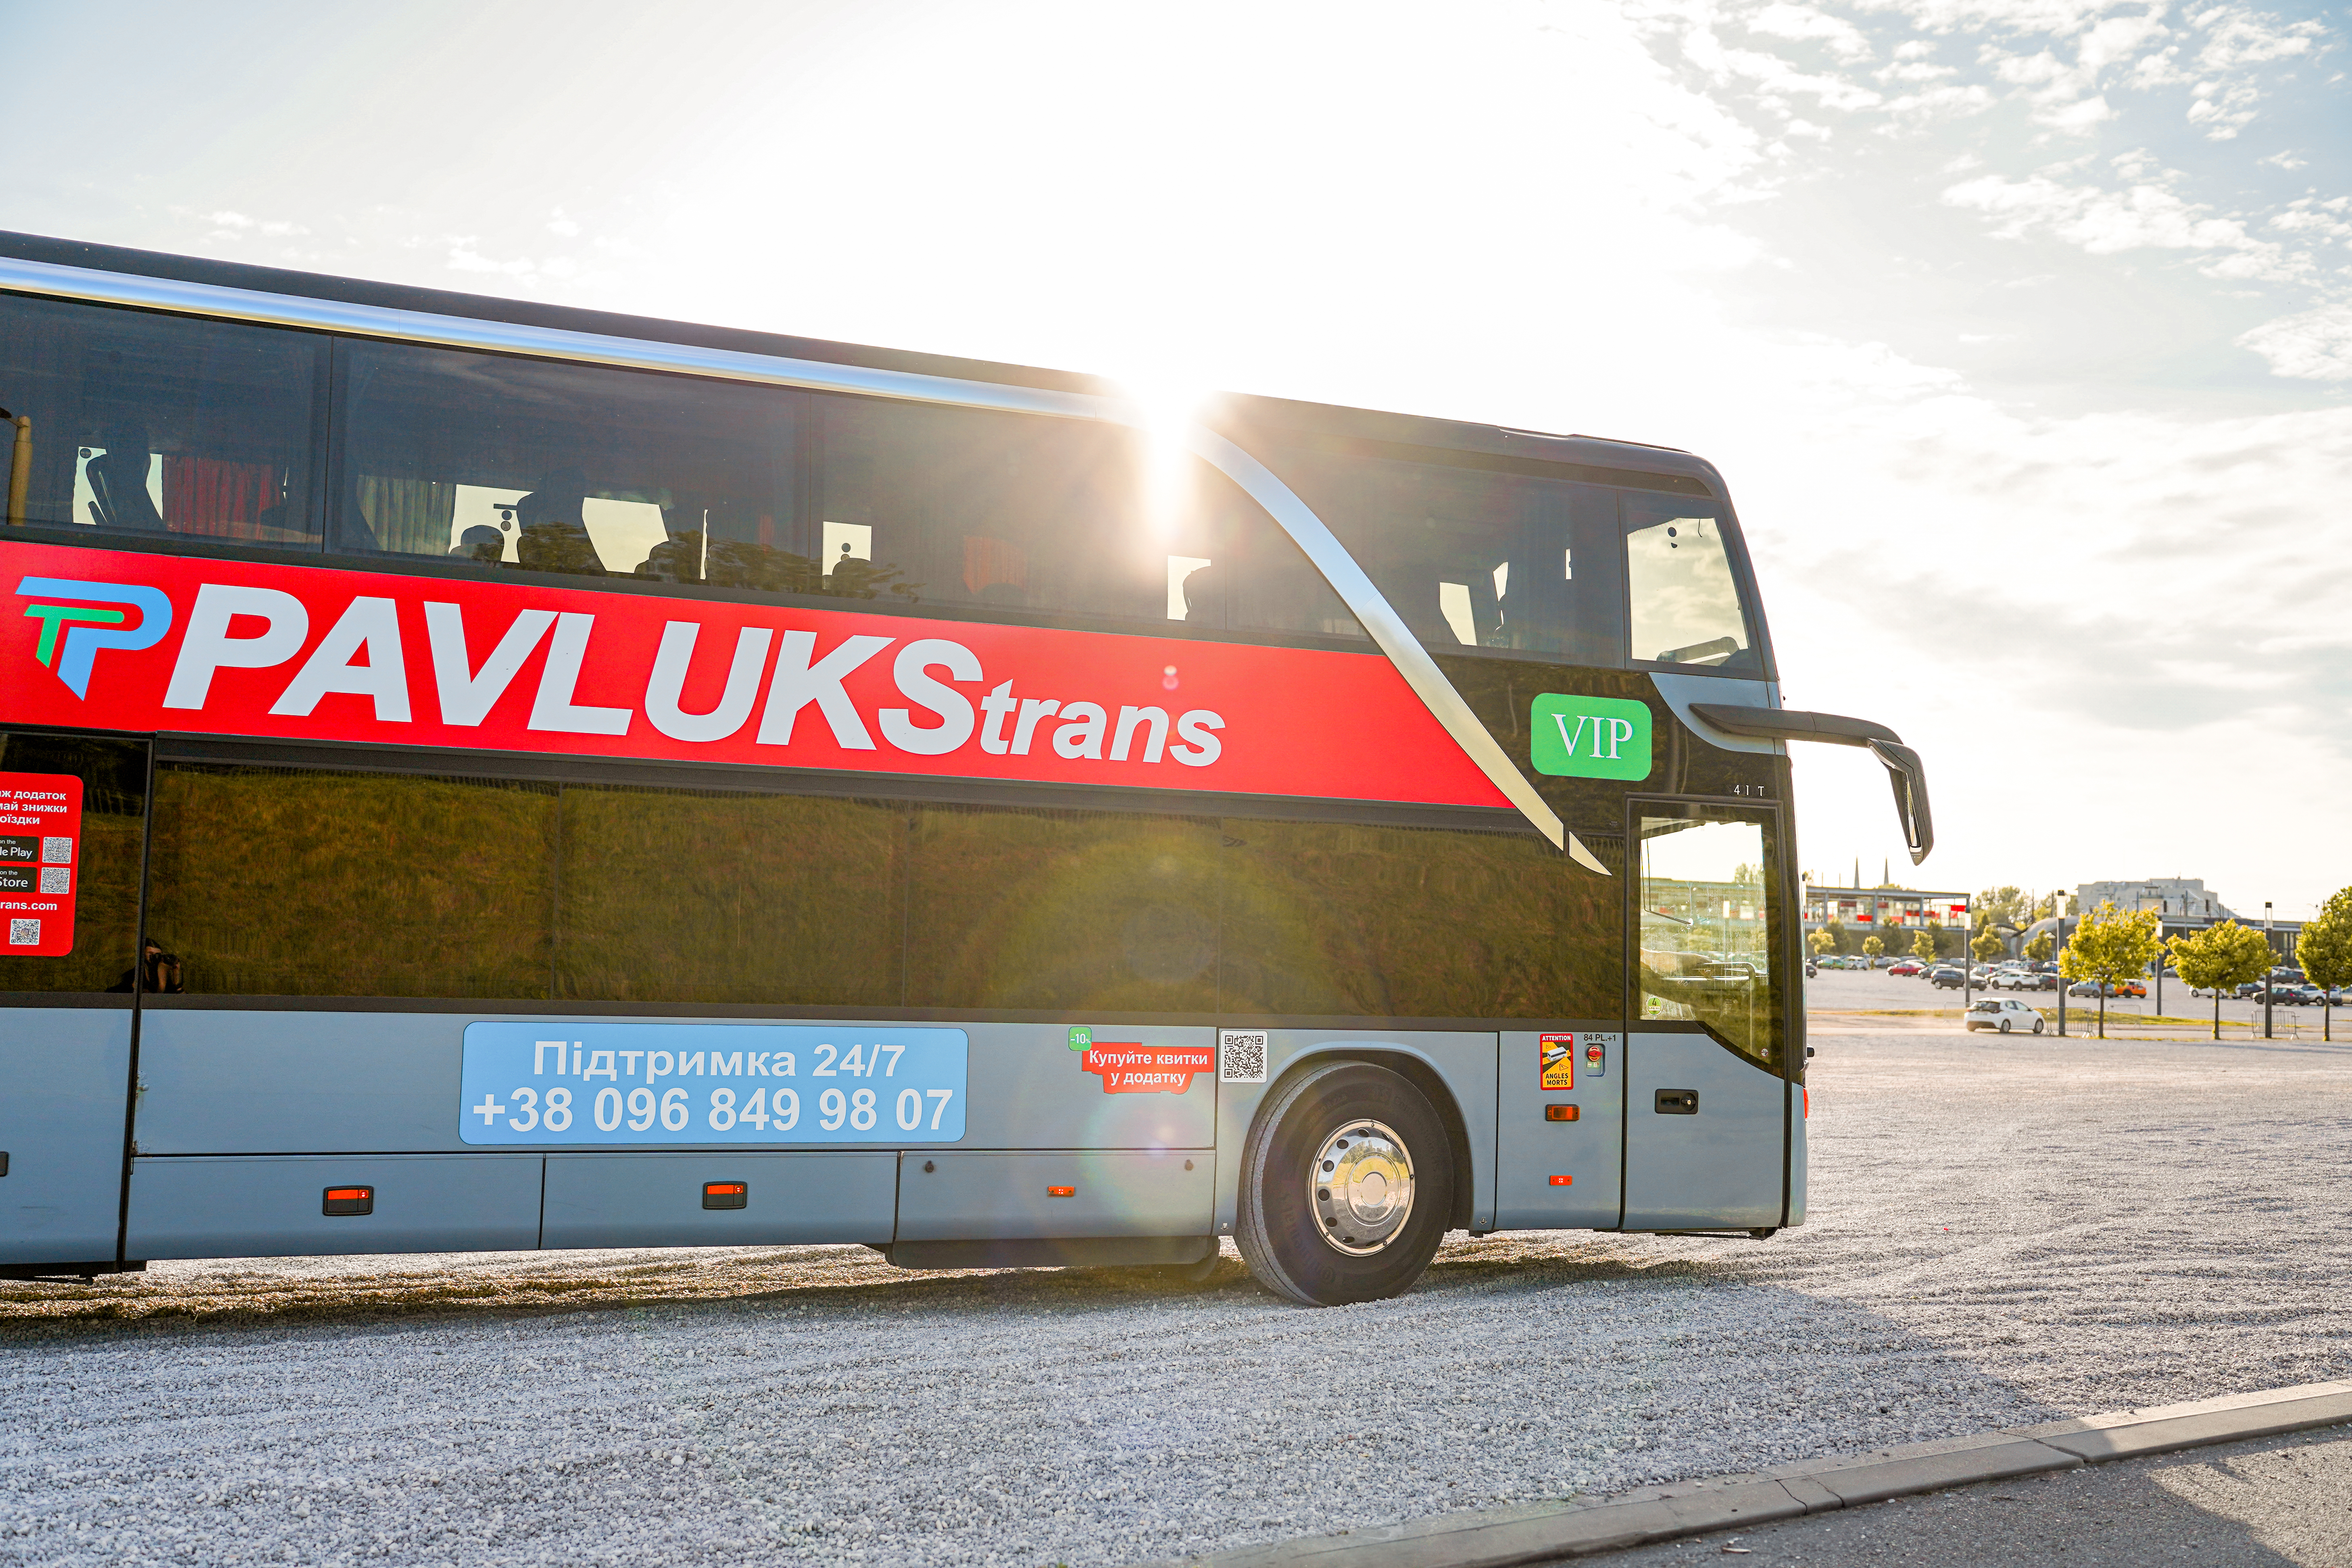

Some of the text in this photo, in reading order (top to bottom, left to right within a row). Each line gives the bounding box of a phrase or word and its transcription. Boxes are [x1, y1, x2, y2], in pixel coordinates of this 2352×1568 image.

[1551, 713, 1633, 759] VIP
[14, 791, 66, 800] додаток
[22, 804, 67, 813] знижки
[10, 847, 33, 859] Play
[1652, 998, 1657, 1006] 4
[534, 1040, 905, 1084] Підтримка 24/7
[1089, 1050, 1207, 1067] Купуйте квитки
[1111, 1072, 1186, 1086] у додатку
[473, 1087, 953, 1132] +38 096 849 98 07
